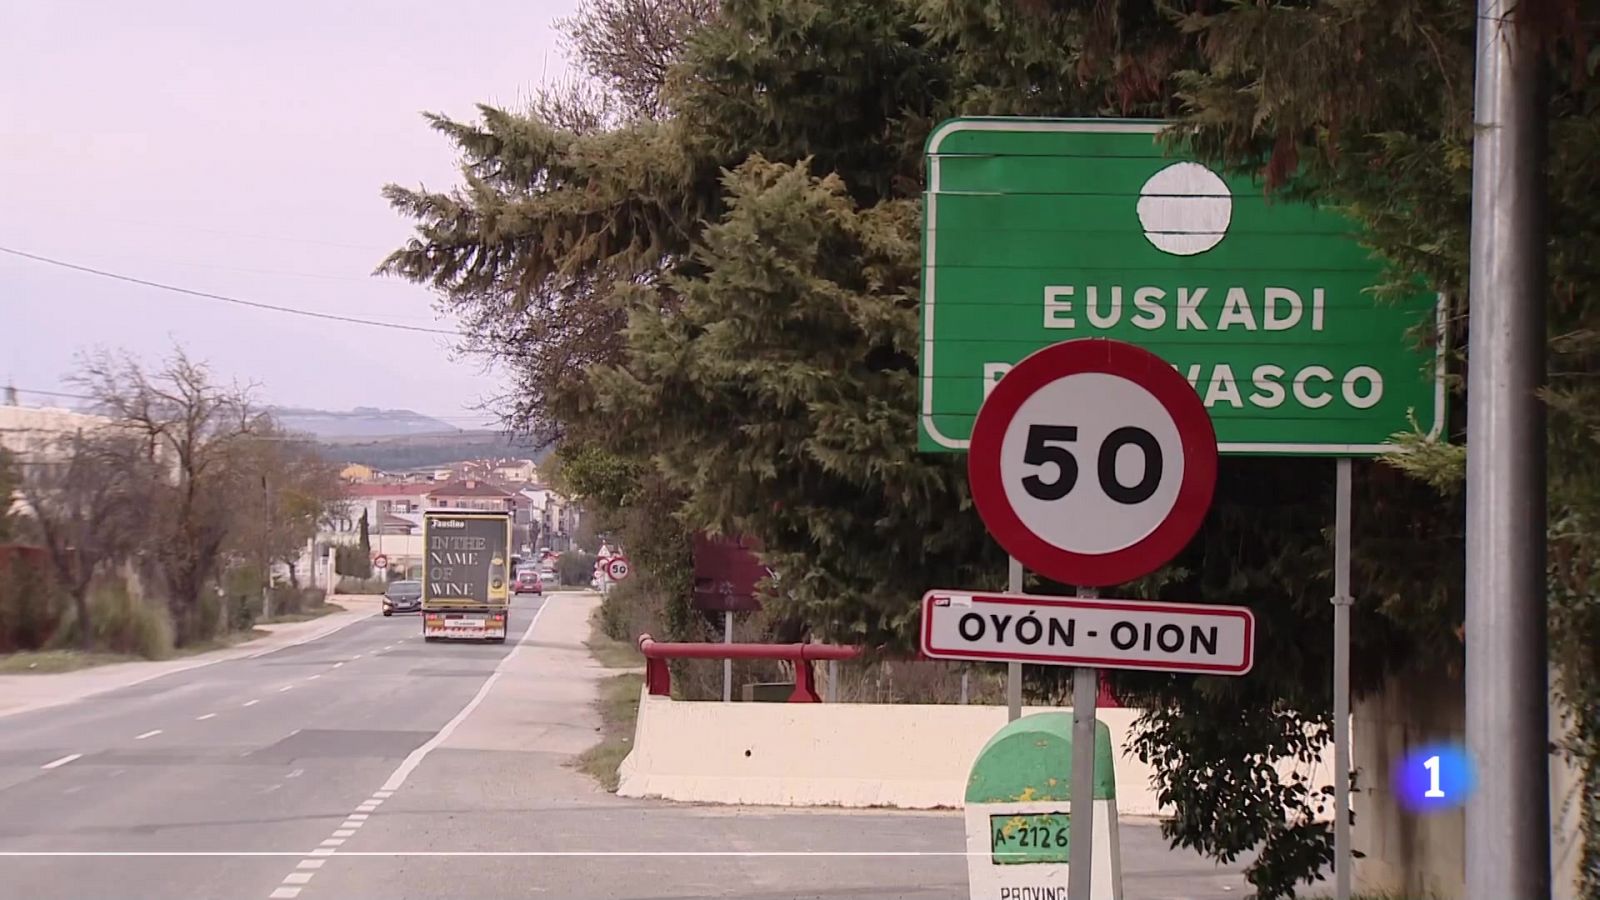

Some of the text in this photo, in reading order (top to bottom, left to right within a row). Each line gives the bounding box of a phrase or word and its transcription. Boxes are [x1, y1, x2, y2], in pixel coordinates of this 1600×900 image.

[1043, 285, 1326, 331] EUSKADI
[1021, 424, 1163, 504] 50
[431, 552, 478, 566] NAME
[430, 567, 453, 581] OF
[612, 564, 627, 574] 50
[431, 582, 474, 596] WINE
[958, 610, 1076, 647] OYÓN
[1110, 621, 1218, 655] OION
[995, 826, 1068, 848] A-2126
[1000, 886, 1066, 900] PROVINC
